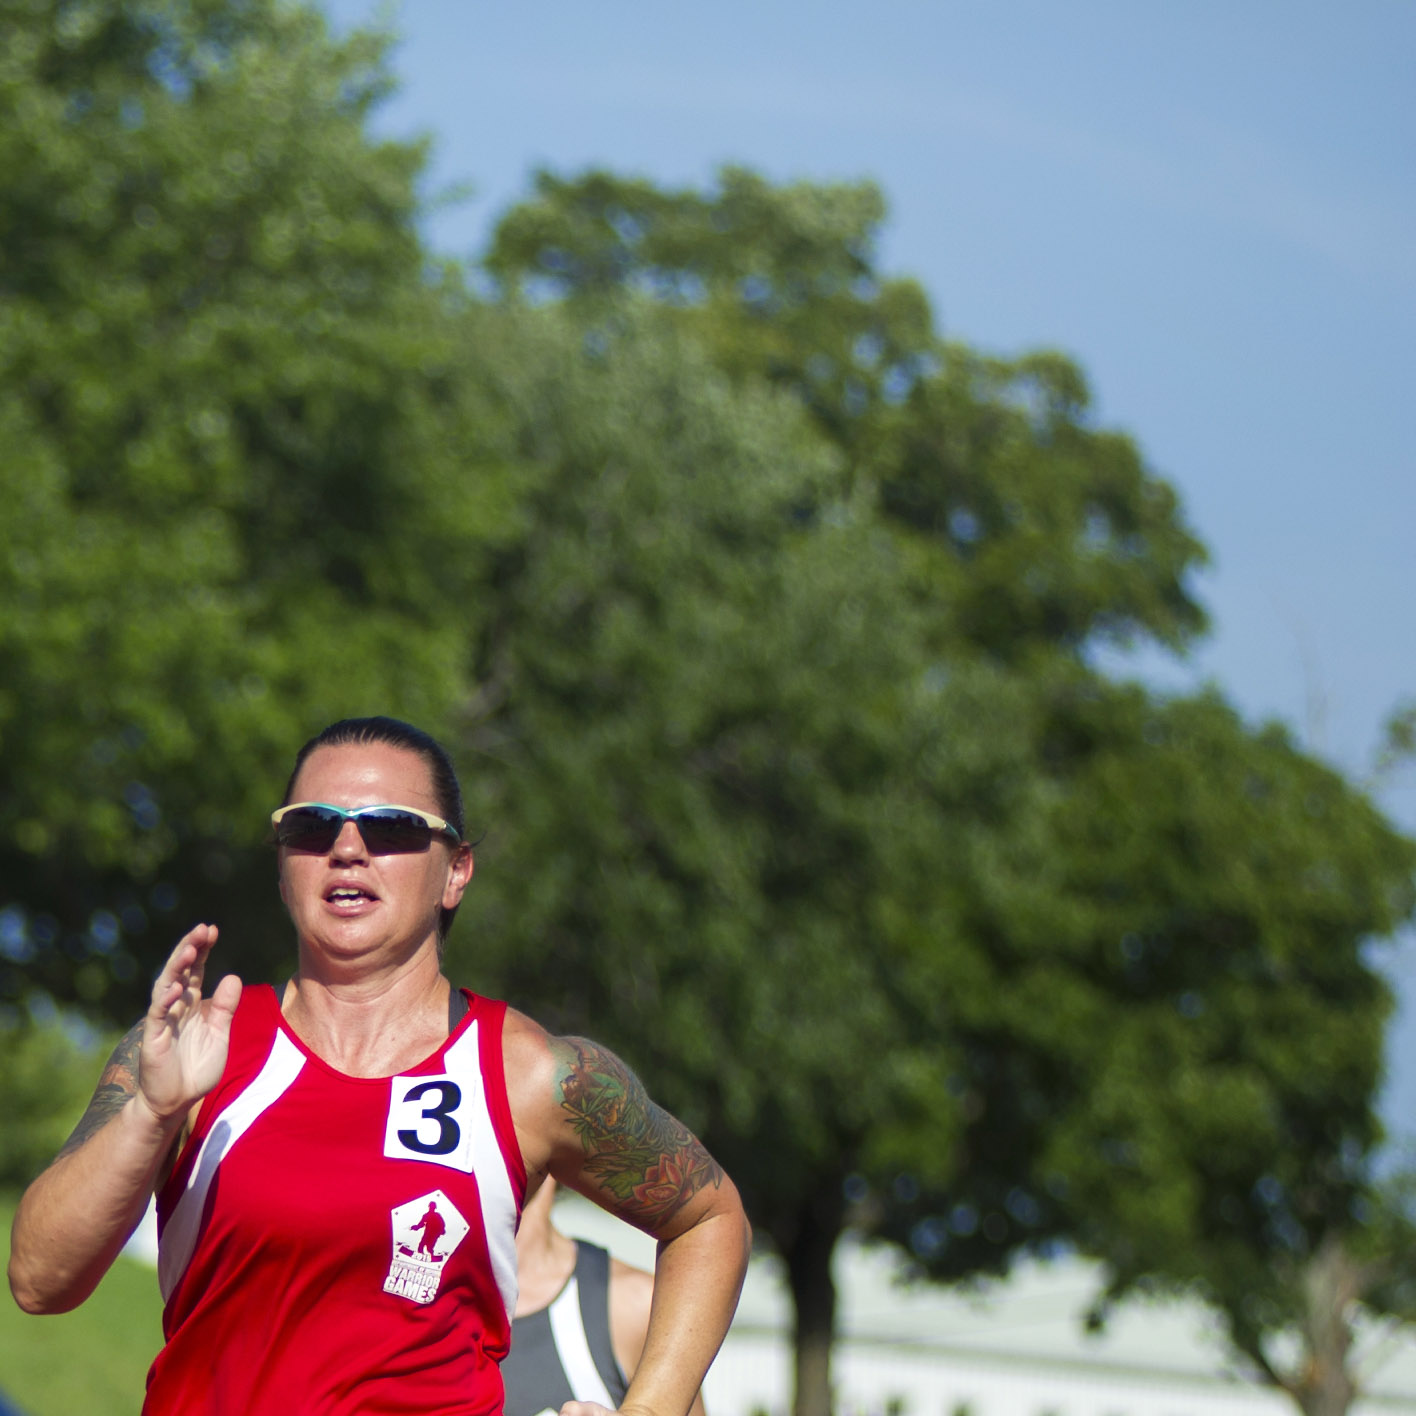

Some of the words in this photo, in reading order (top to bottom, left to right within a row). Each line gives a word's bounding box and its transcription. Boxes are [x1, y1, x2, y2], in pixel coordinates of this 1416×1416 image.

[397, 1080, 462, 1155] 3
[383, 1276, 437, 1303] GAMES
[389, 1262, 441, 1291] WARRIOR
